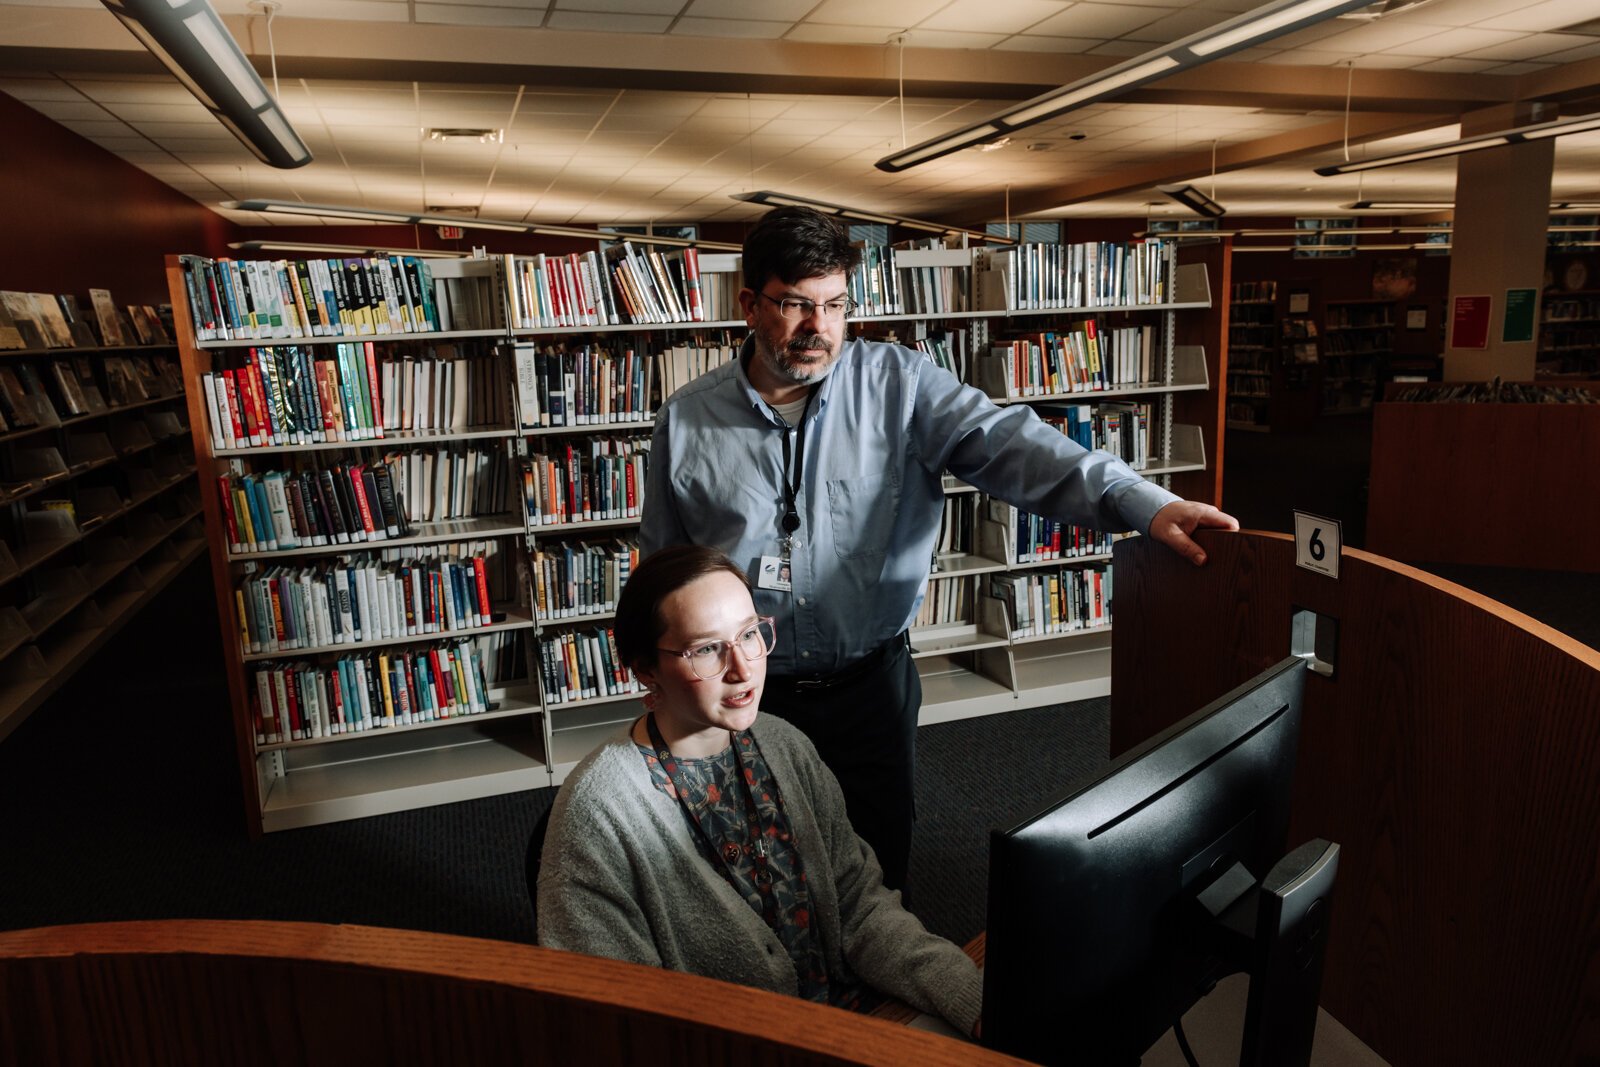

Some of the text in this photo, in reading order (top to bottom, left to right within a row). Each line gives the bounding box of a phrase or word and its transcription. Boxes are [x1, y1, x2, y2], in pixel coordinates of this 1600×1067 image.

[332, 272, 345, 308] Windows 10
[354, 273, 362, 297] Windows
[366, 273, 377, 305] Windows 10
[395, 277, 403, 297] Hacking
[409, 273, 419, 300] Facebook
[525, 359, 533, 391] STRONG'S
[356, 482, 366, 508] ASTROLOGY
[1310, 528, 1325, 561] 6
[340, 590, 350, 612] NOISE
[399, 690, 409, 711] NATION
